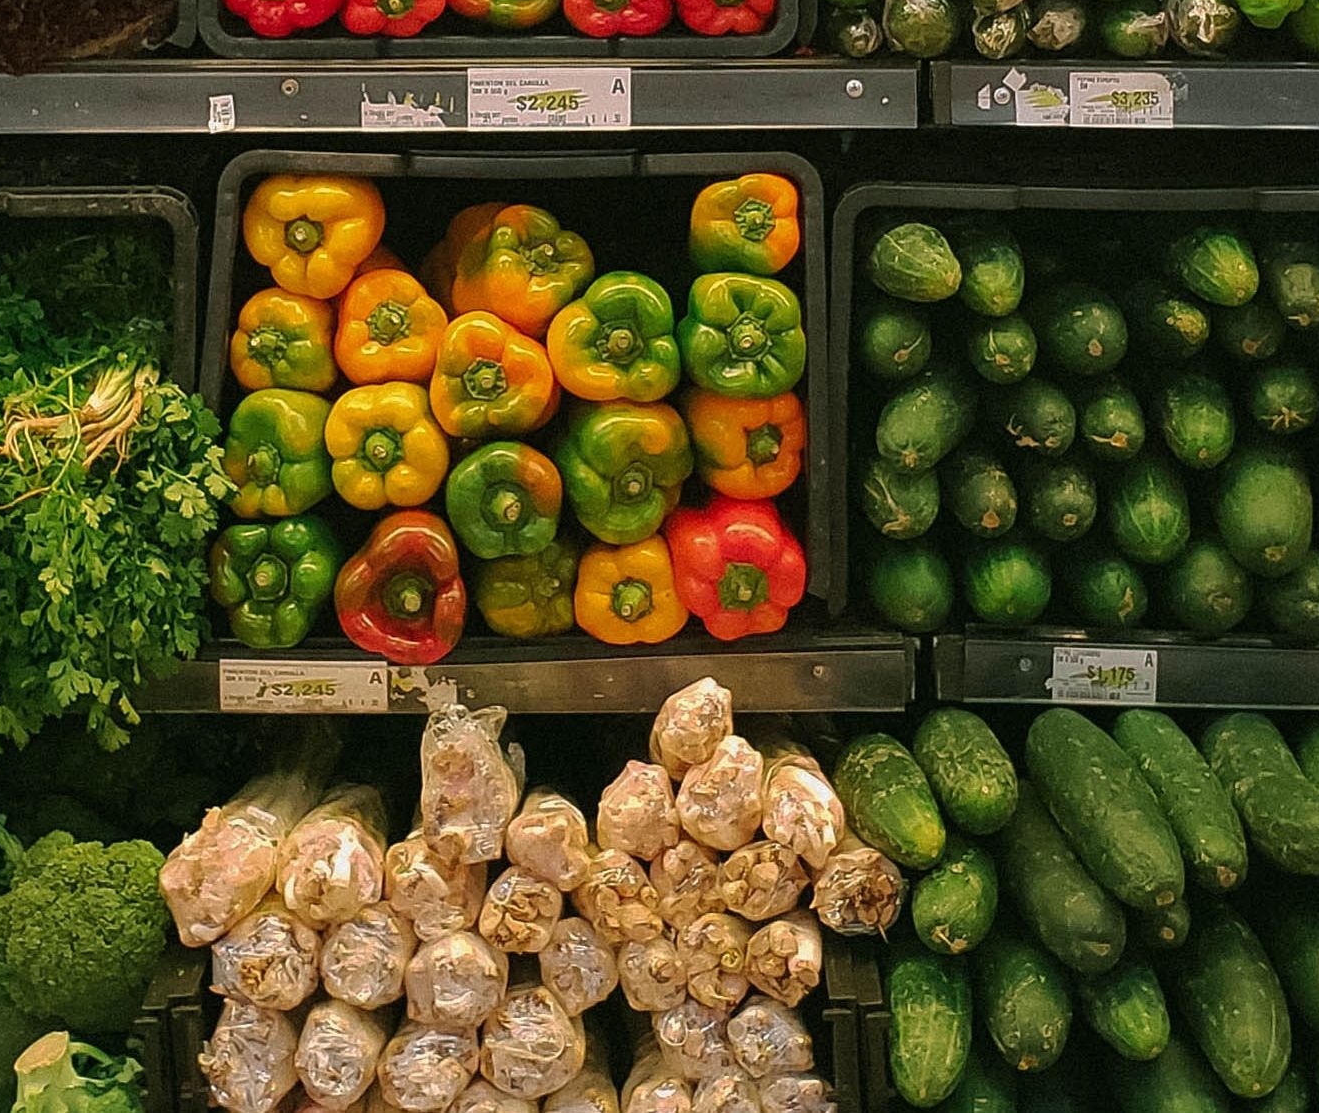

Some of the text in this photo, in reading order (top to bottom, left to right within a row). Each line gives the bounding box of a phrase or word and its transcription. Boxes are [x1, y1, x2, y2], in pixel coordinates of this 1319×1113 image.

[612, 78, 625, 94] A
[516, 95, 579, 113] $2,245
[1111, 90, 1160, 108] $3,235
[1144, 653, 1153, 667] A
[369, 672, 382, 684] A
[1087, 665, 1136, 684] $1,175
[271, 683, 336, 698] $2,245
